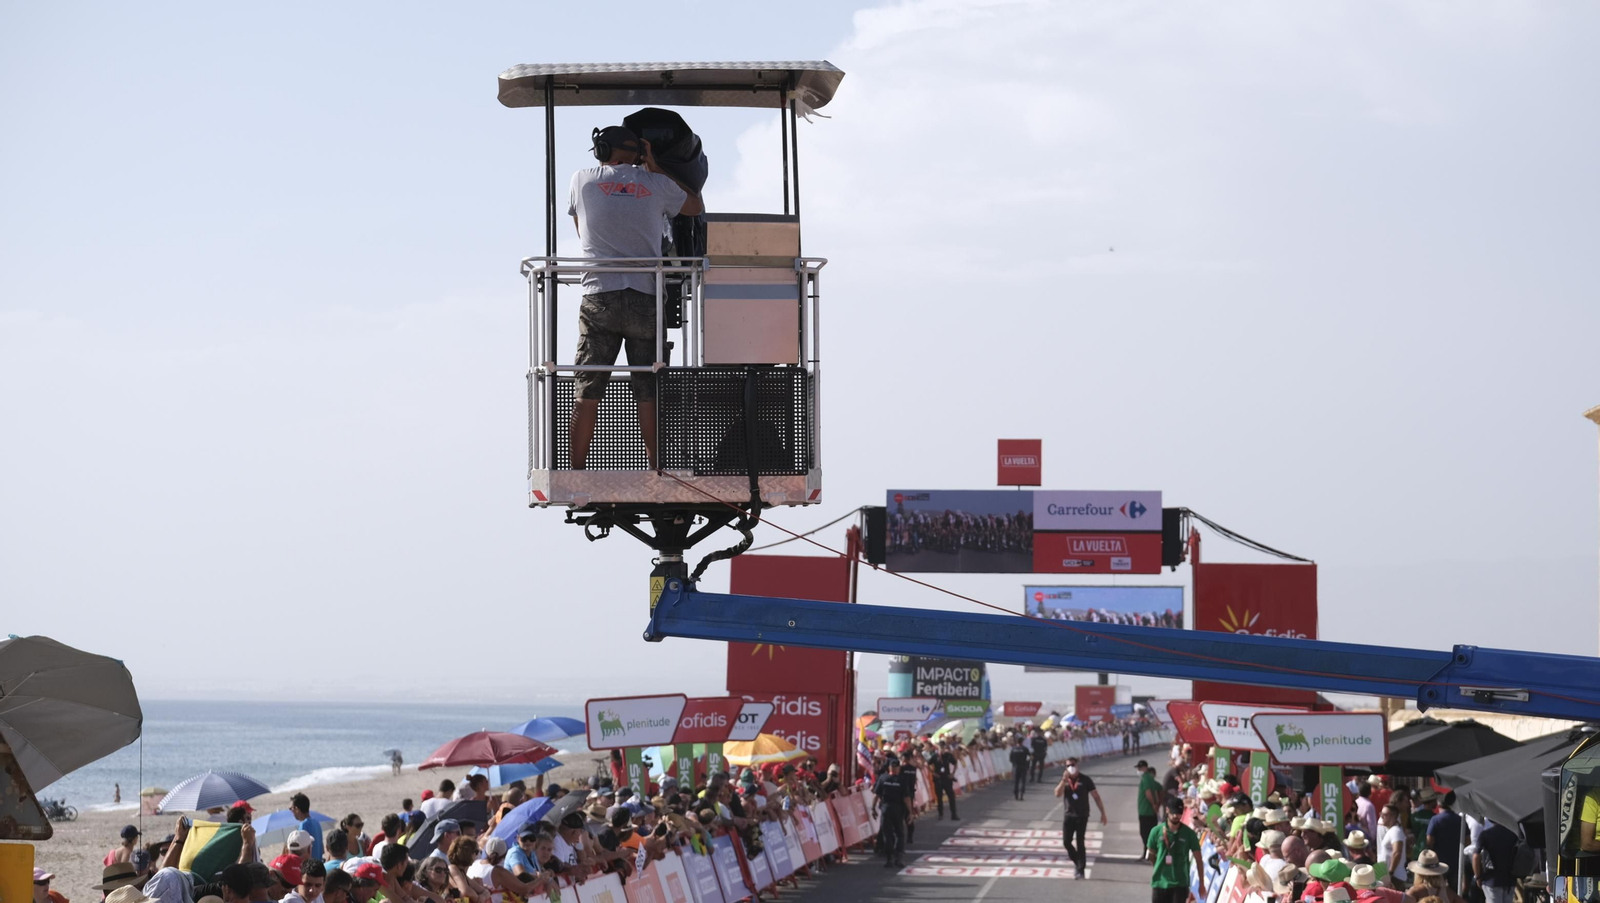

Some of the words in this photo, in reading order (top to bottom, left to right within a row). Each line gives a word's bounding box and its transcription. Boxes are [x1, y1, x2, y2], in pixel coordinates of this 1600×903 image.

[1004, 457, 1012, 465] LA
[1013, 457, 1035, 465] VUELTA
[1047, 503, 1114, 516] Carrefour
[1073, 540, 1085, 552] LA
[1086, 540, 1122, 552] VUELTA
[916, 682, 980, 697] Fertiberia
[881, 704, 915, 713] Carrefour
[626, 717, 671, 731] plenitude
[679, 712, 727, 729] ofidis
[1312, 734, 1372, 747] plenitude
